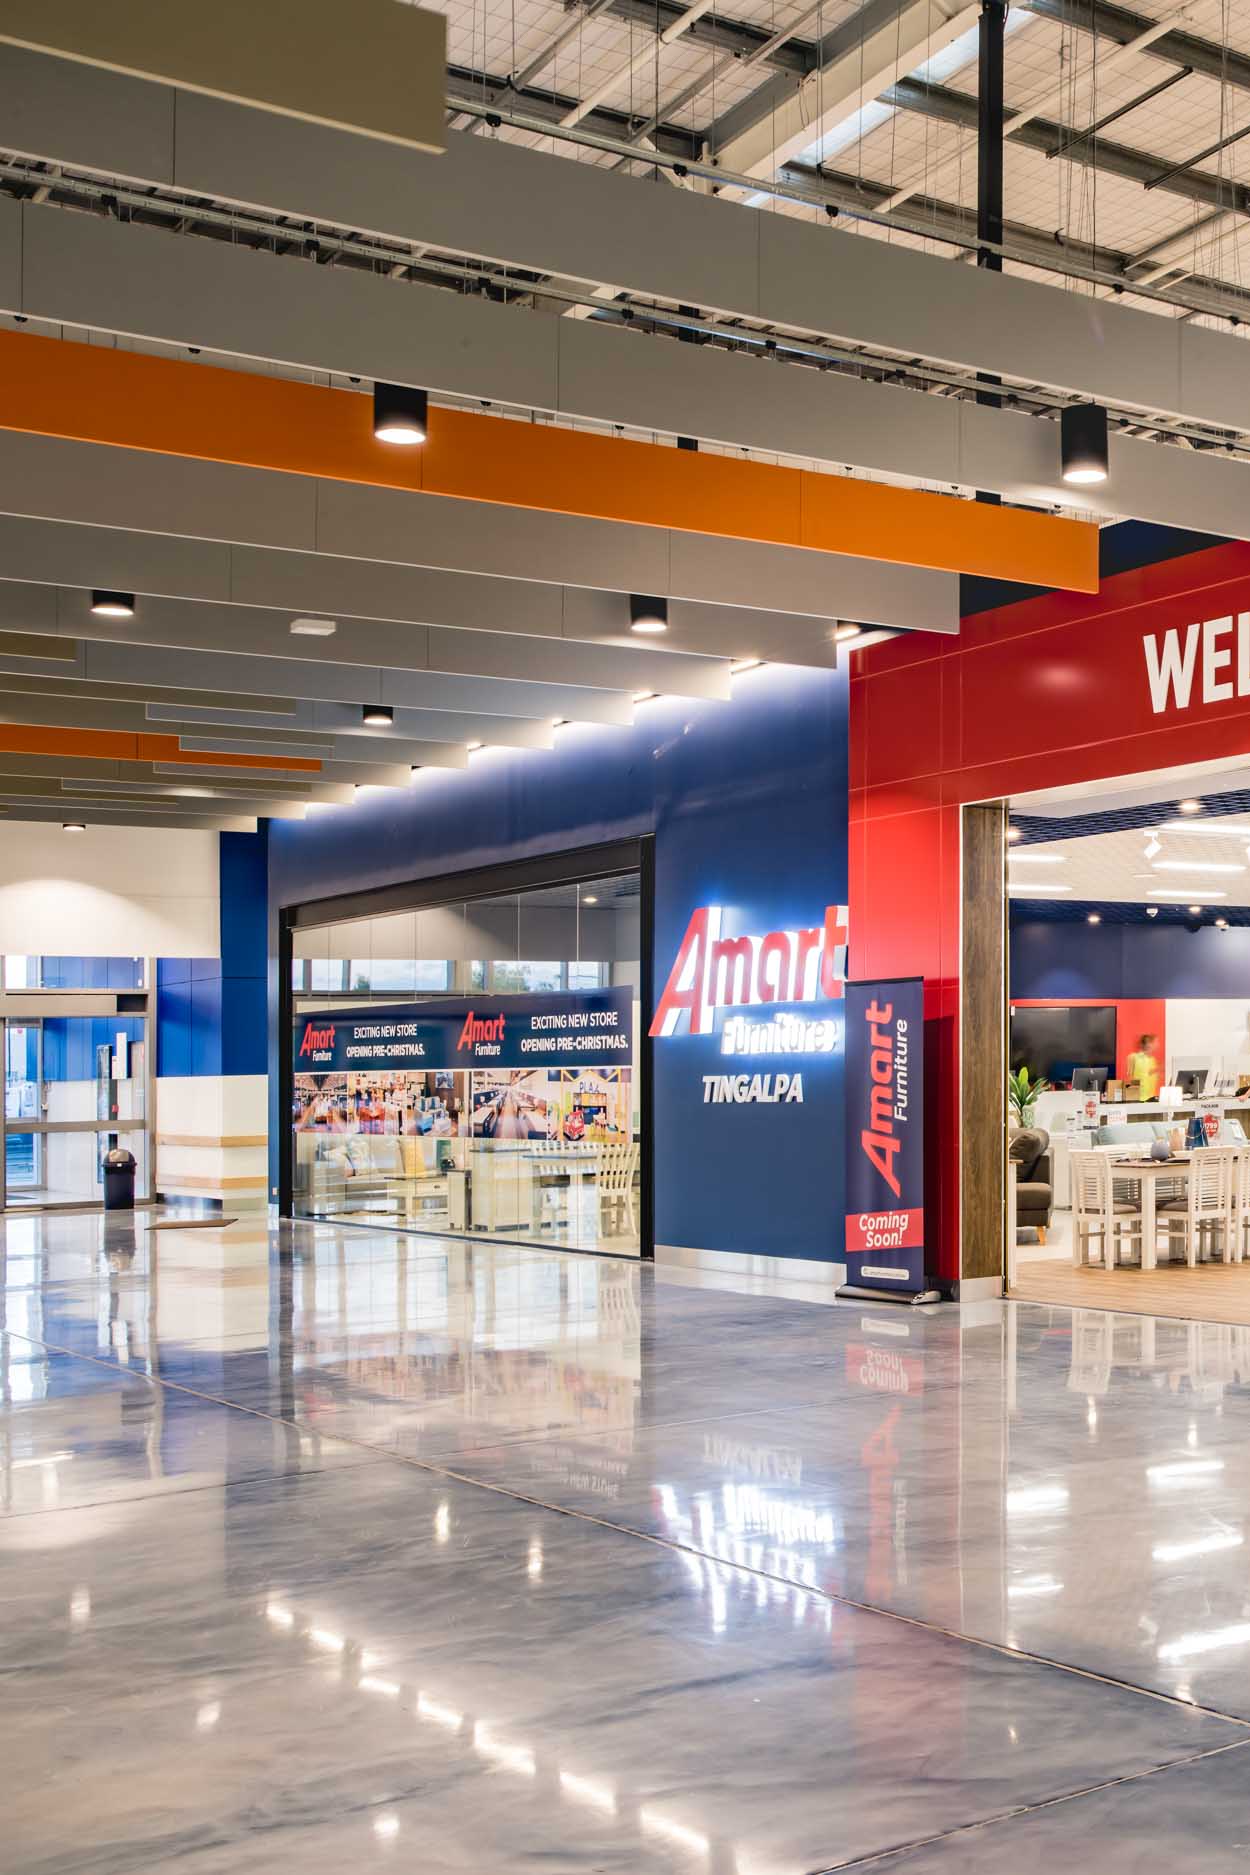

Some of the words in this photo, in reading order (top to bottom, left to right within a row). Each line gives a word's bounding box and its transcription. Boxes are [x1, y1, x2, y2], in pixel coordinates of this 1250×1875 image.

[648, 906, 848, 1036] Amart
[353, 1026, 380, 1039] EXCITING
[381, 1025, 396, 1038] NEW
[397, 1024, 418, 1036] STORE
[457, 1010, 506, 1051] Amart
[531, 1016, 567, 1030] EXCITING
[568, 1014, 589, 1028] NEW
[590, 1011, 618, 1027] STORE
[299, 1022, 336, 1057] Amart
[521, 1038, 556, 1053] OPENING
[557, 1034, 628, 1050] PRE-CHRISTMAS.
[720, 1013, 838, 1054] Furniture
[346, 1046, 372, 1058] OPENING
[373, 1044, 425, 1057] PRE-CHRISTMAS.
[475, 1043, 501, 1056] Furniture
[894, 1019, 908, 1122] Furniture
[702, 1073, 803, 1103] TINGALPA
[861, 1000, 901, 1198] Amart
[859, 1210, 909, 1231] Coming
[865, 1227, 904, 1247] Soon!
